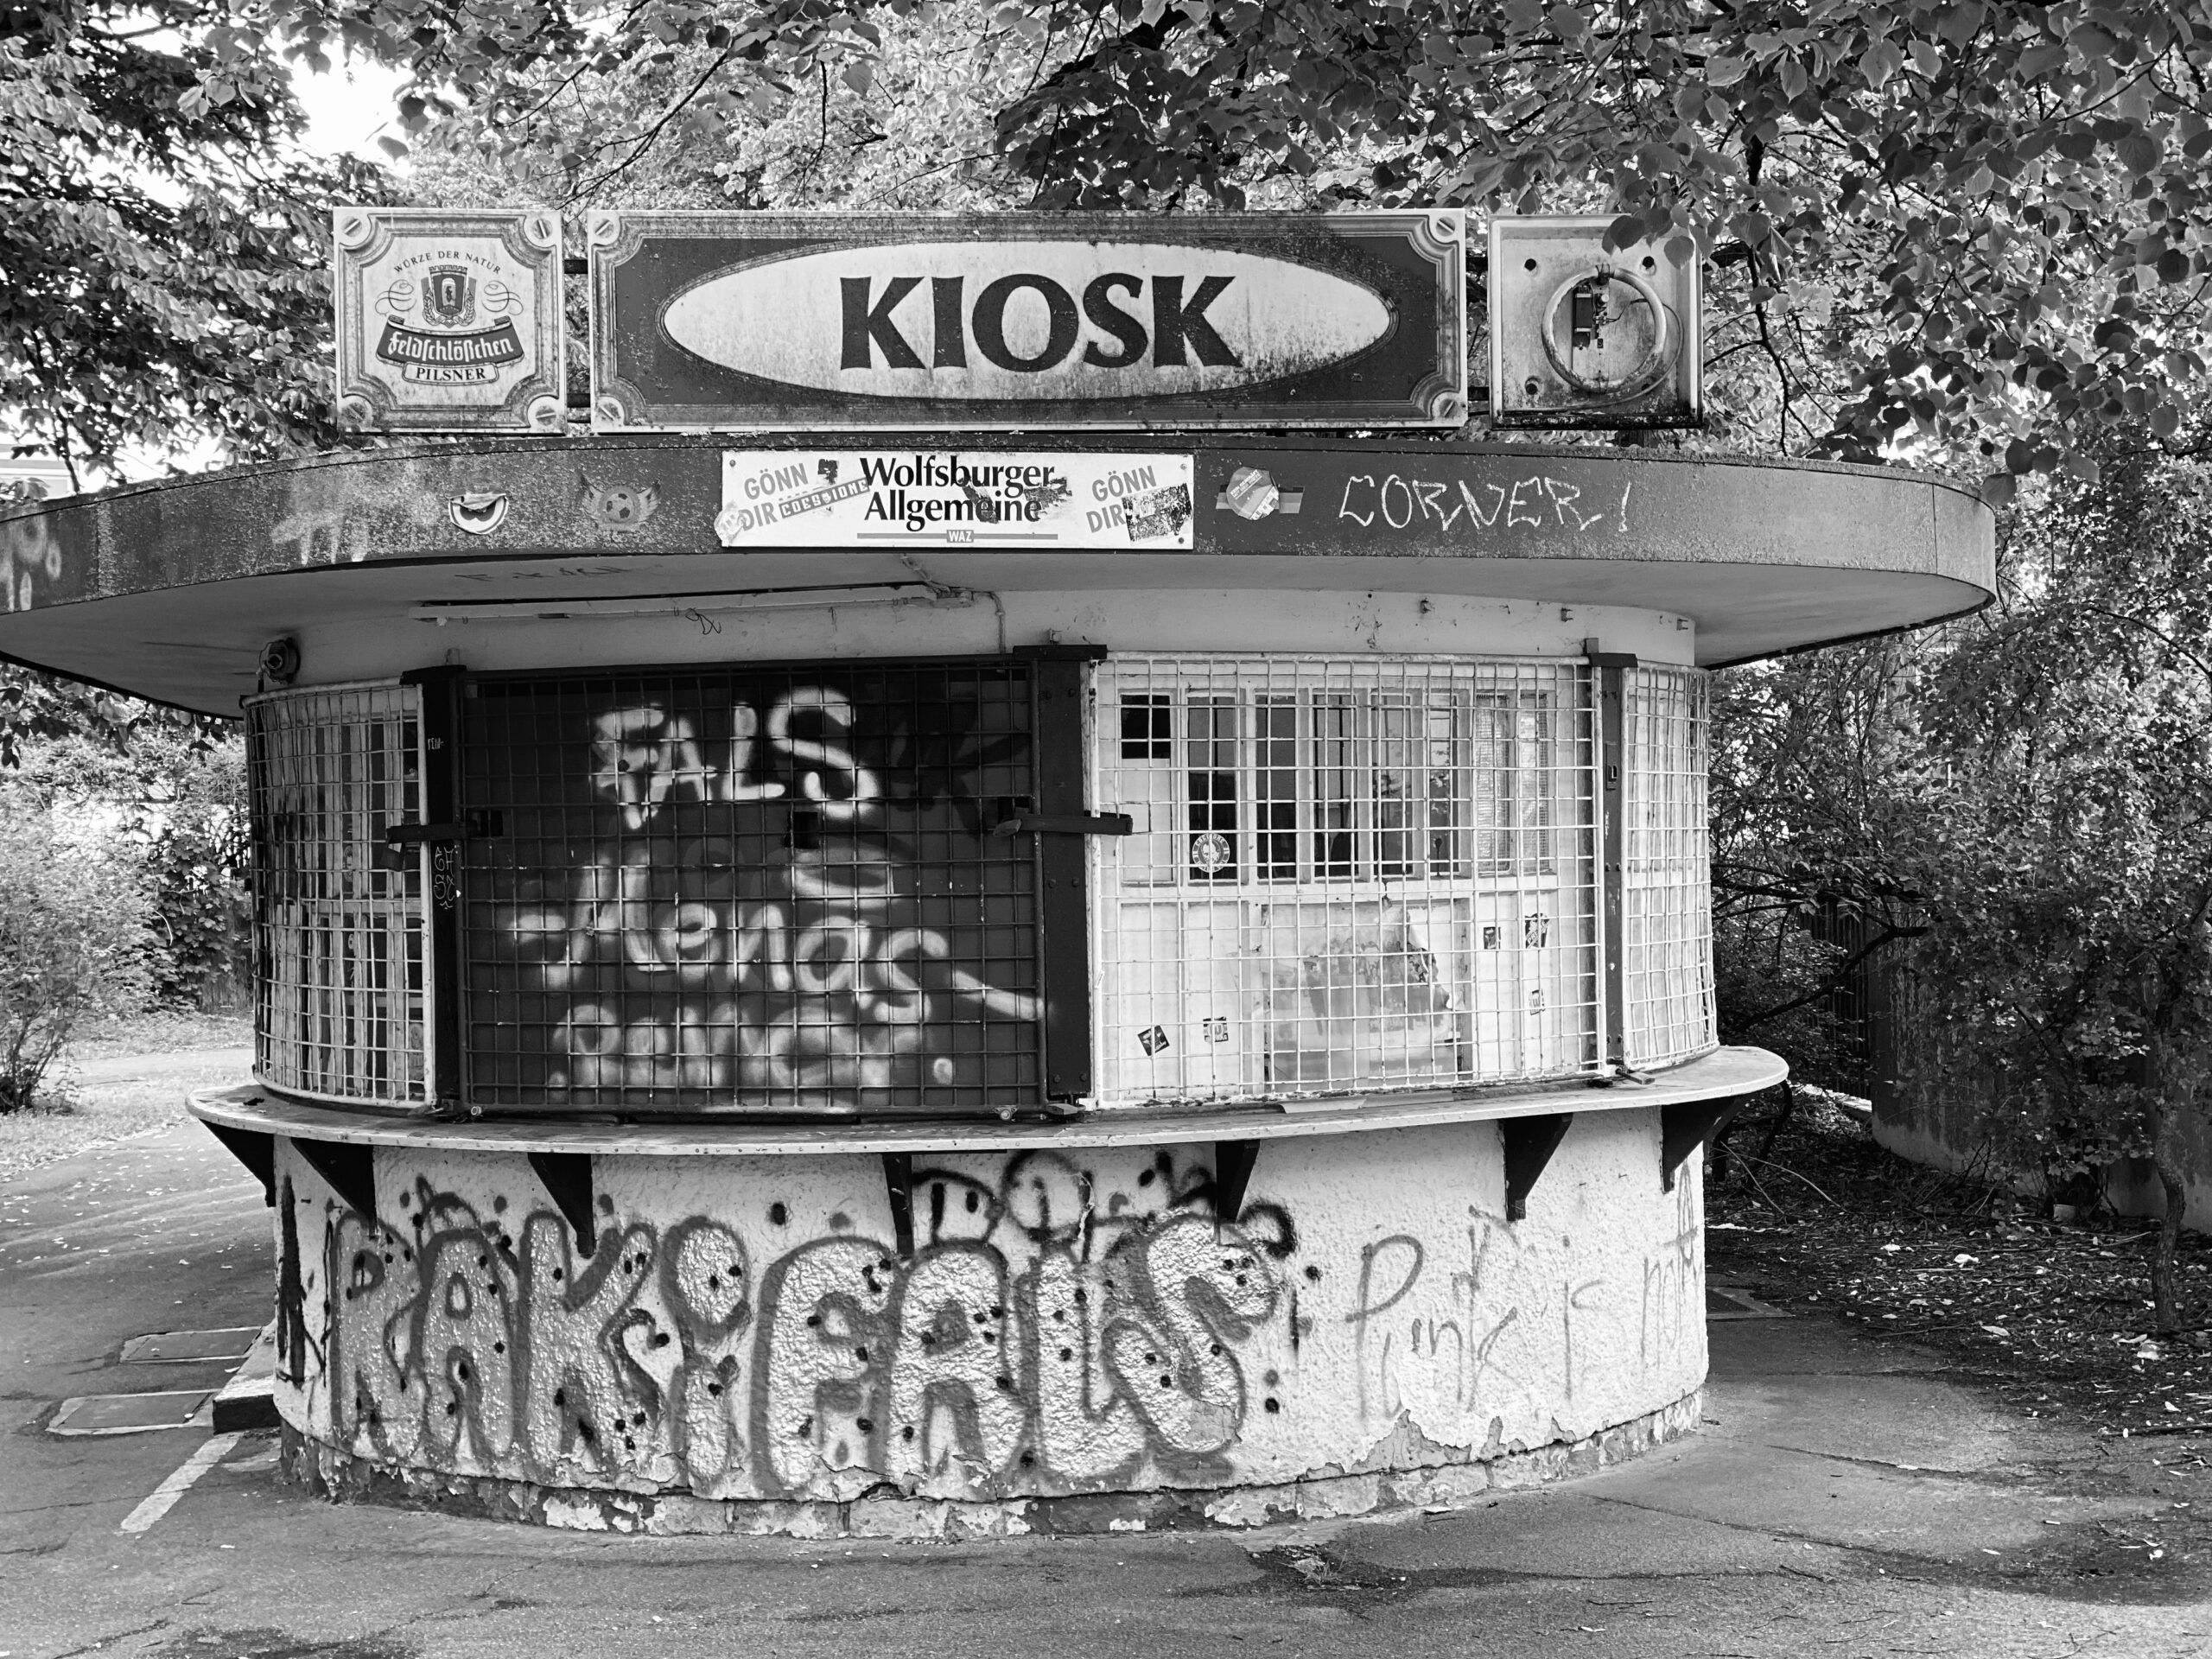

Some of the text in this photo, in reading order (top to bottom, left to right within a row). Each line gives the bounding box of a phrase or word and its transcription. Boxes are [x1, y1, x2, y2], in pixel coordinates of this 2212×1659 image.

[393, 251, 501, 275] WÜRZE DER NATUR
[839, 272, 1243, 373] KIOSK
[416, 366, 487, 382] PILSNER
[744, 462, 809, 500] GÖNN
[859, 454, 1056, 499] Wolfsburger
[1091, 465, 1157, 502] GÖNN
[737, 501, 779, 531] DIR
[863, 489, 1042, 532] Allgemeine
[1085, 504, 1127, 534] DIR
[948, 531, 973, 543] WAZ
